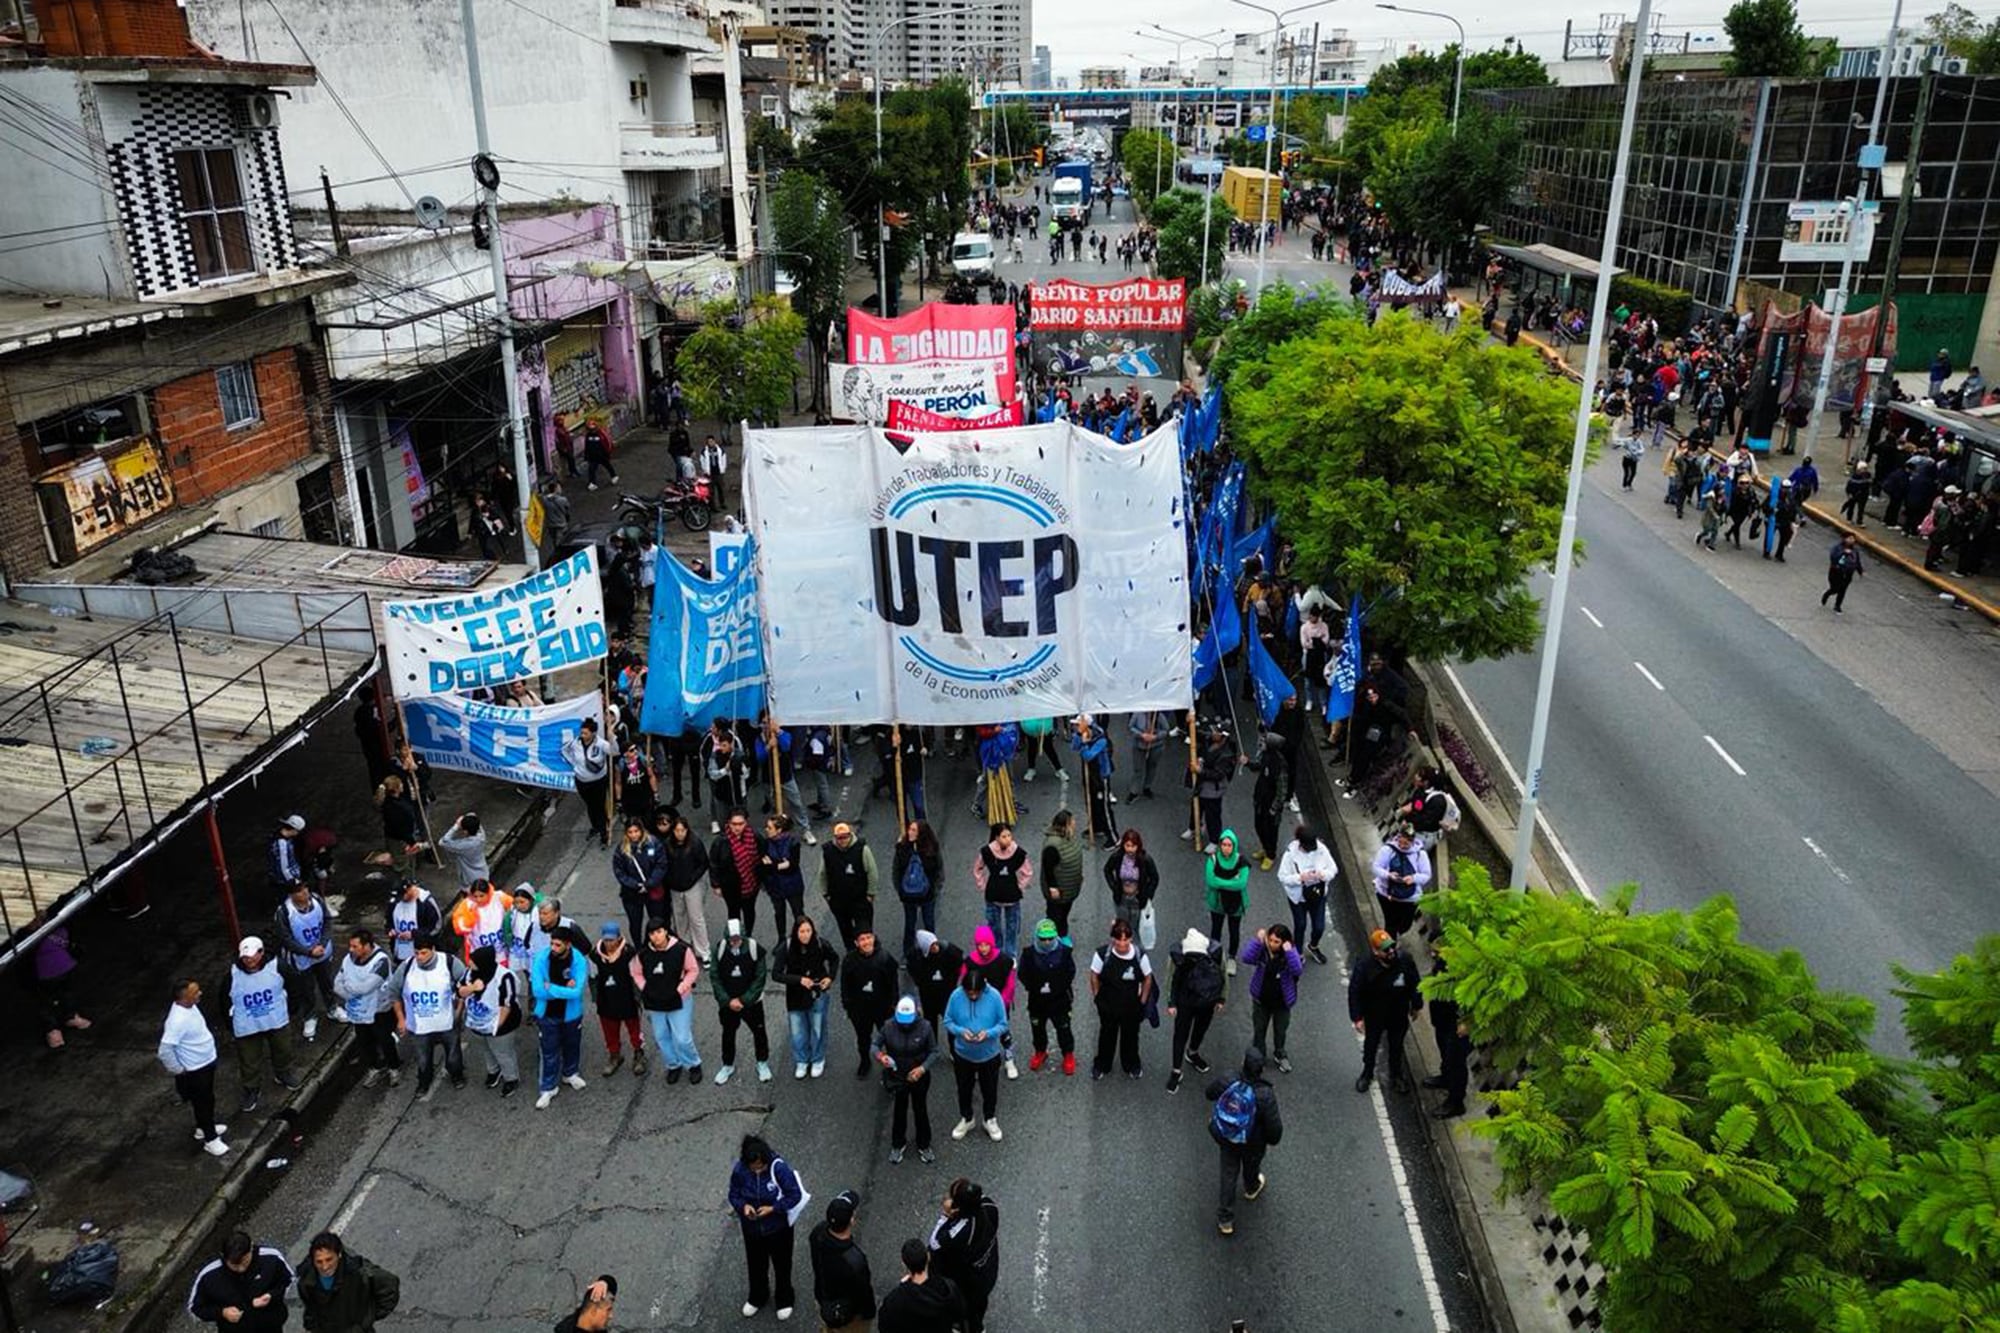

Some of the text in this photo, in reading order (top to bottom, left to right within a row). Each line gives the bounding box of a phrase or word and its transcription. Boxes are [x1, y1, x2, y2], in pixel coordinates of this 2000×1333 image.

[1031, 283, 1182, 302] FRENTE POPULAR
[1031, 306, 1183, 325] DARIO SANTILLAN
[855, 328, 1008, 363] LA DIGNIDAD
[886, 380, 985, 396] CORRIENTE POPULAR
[925, 391, 987, 412] PERÓN
[896, 404, 945, 427] FRENTE
[891, 476, 906, 493] de
[903, 463, 989, 485] Trabajadores
[992, 466, 1002, 481] y
[1004, 466, 1070, 525] Trabajadoras
[387, 551, 592, 624] AVELLANEDA
[870, 527, 1080, 638] UTEP
[428, 621, 608, 693] DOCK SUD
[704, 620, 757, 676] DE
[904, 659, 1062, 700] de la Economía Popular
[426, 751, 473, 768] RRIENTE
[243, 989, 273, 1006] CCC
[410, 991, 439, 1005] CCC
